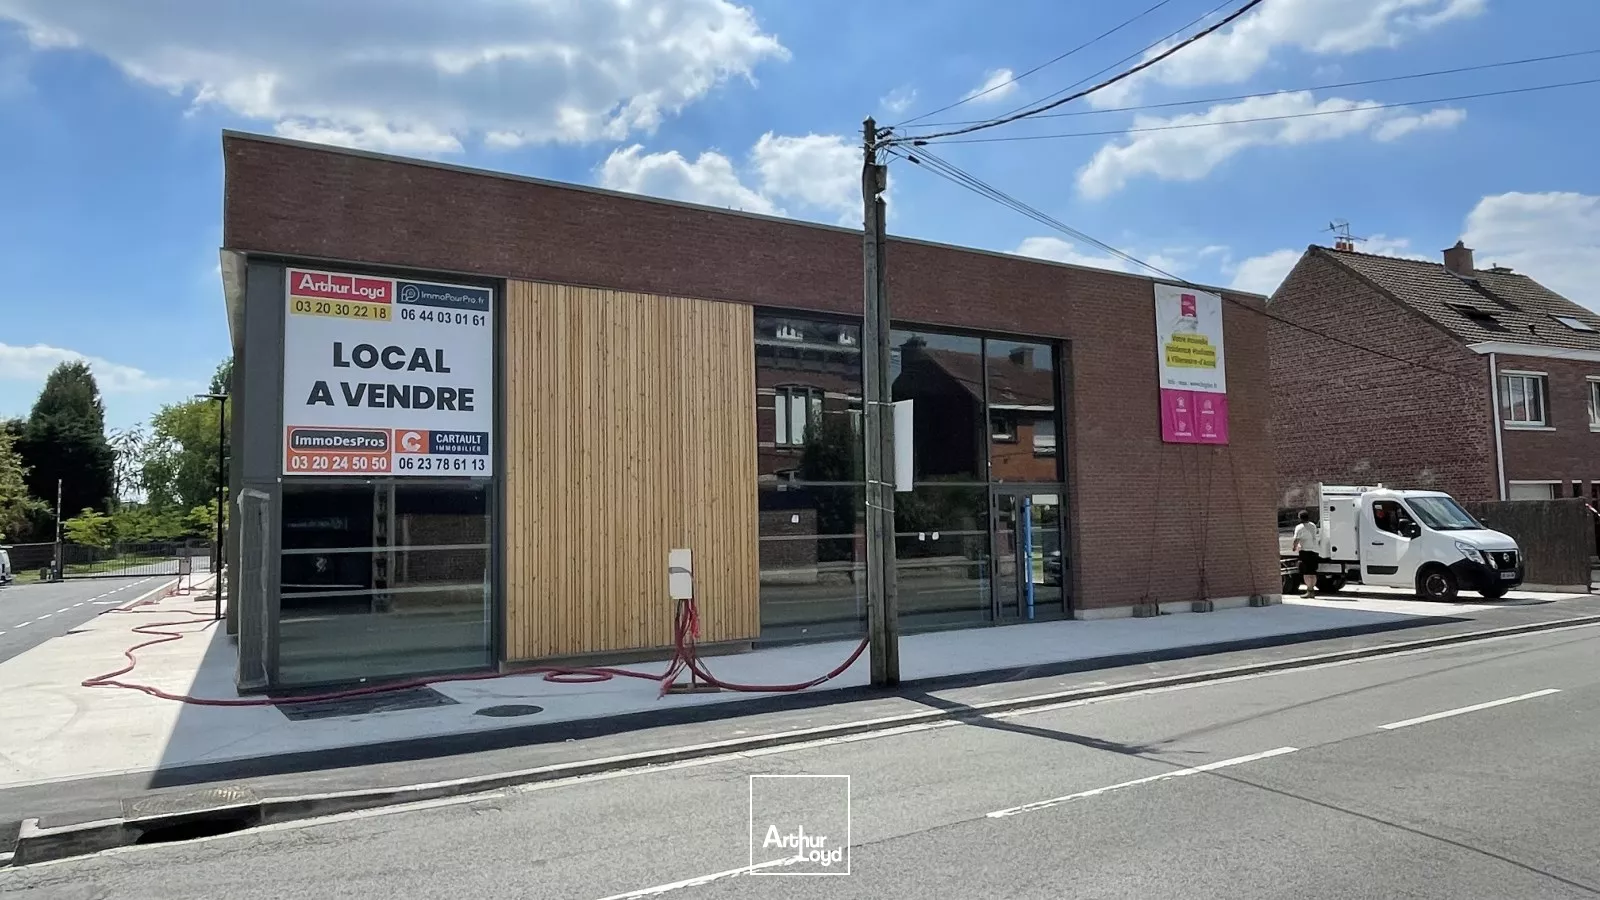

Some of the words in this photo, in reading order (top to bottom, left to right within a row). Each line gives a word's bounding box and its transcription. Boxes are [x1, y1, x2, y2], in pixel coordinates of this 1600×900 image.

[299, 273, 350, 294] Arthur
[352, 277, 385, 300] Loyd
[421, 291, 485, 304] ImmoPourPro.fr
[296, 300, 311, 313] 03
[316, 302, 330, 314] 20
[335, 303, 350, 316] 30
[354, 305, 368, 317] 22
[372, 307, 386, 319] 18
[401, 308, 415, 320] 06
[420, 310, 433, 322] 44
[437, 311, 451, 324] 03
[455, 313, 467, 325] 01
[472, 314, 485, 326] 61
[333, 341, 451, 374] LOCAL
[306, 380, 335, 406] A
[340, 382, 475, 412] VENDRE
[295, 435, 385, 448] ImmoDesPros
[436, 434, 481, 444] CARTAULT
[291, 455, 308, 469] 03
[312, 456, 328, 469] 20
[332, 456, 348, 470] 24
[352, 456, 368, 470] 50
[371, 457, 387, 470] 50
[399, 457, 413, 469] 06
[417, 458, 431, 470] 23
[436, 458, 449, 470] 78
[453, 458, 466, 470] 61
[471, 459, 485, 470] 13
